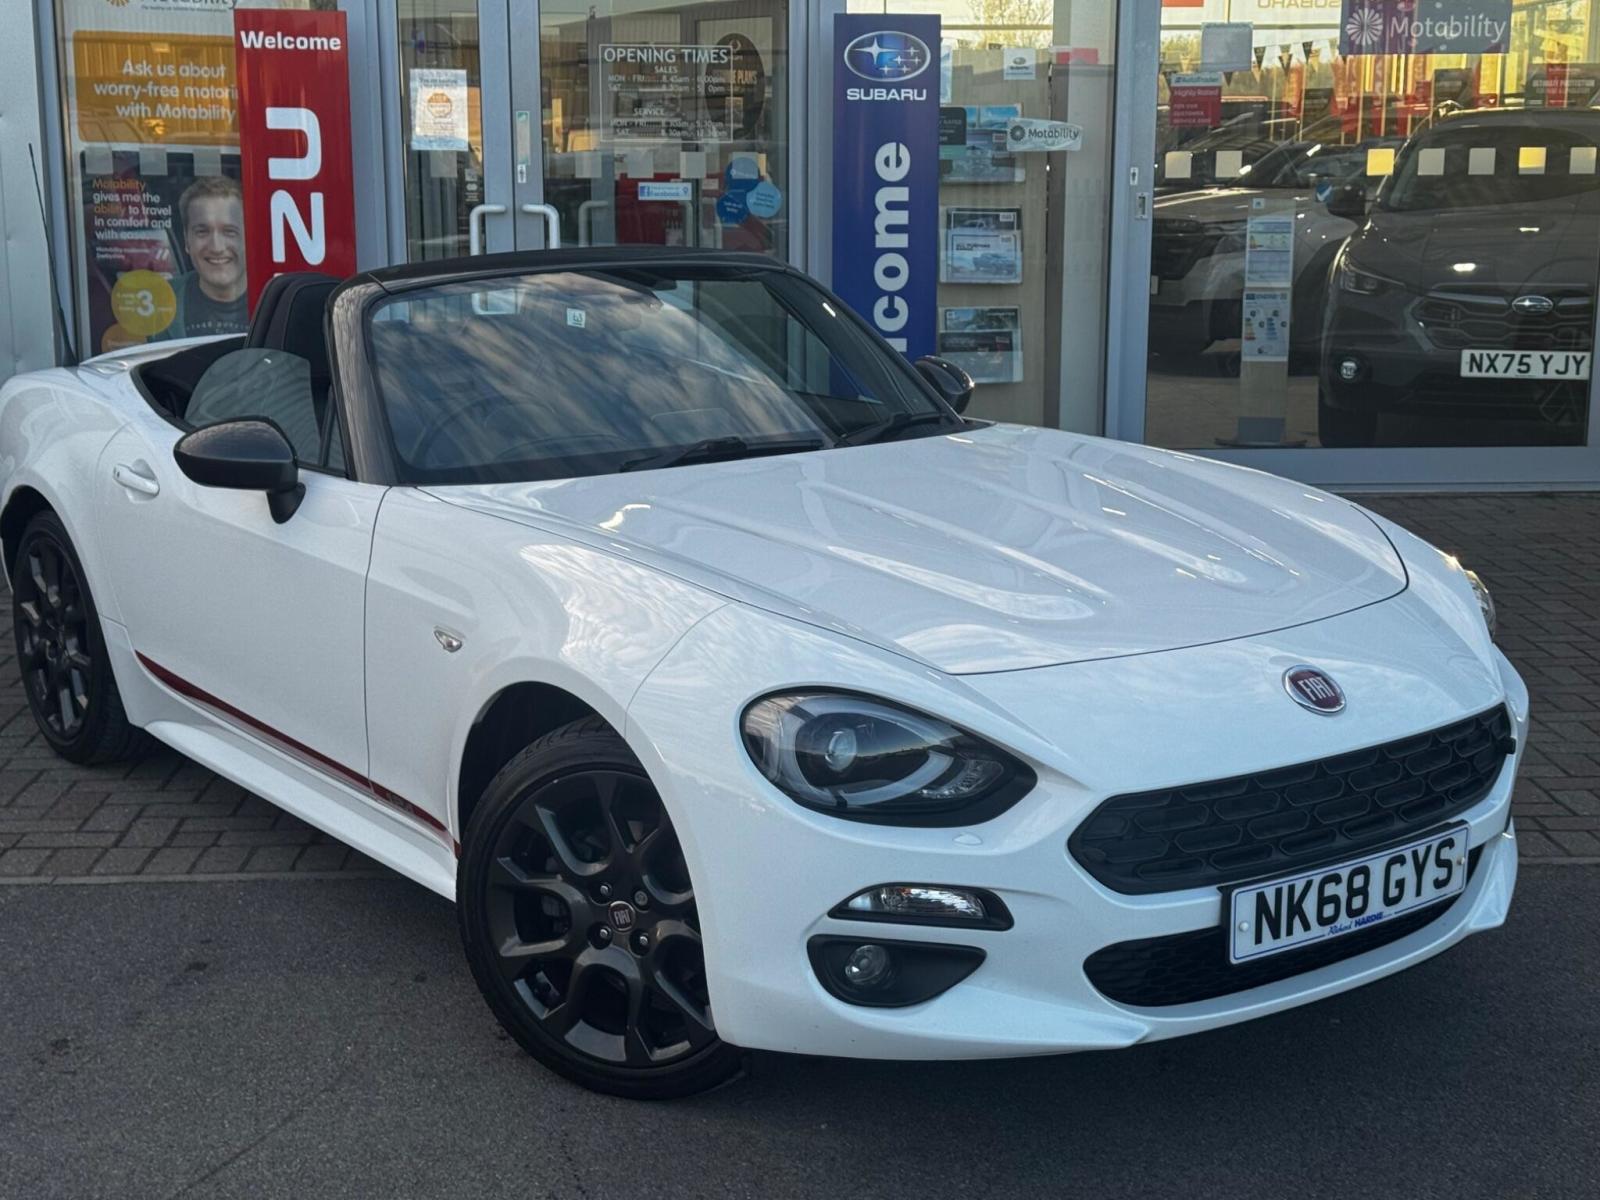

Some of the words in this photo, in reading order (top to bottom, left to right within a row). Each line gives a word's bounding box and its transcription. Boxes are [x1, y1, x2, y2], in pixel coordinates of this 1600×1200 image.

[1390, 14, 1507, 43] Motability
[239, 30, 342, 50] Welcome
[603, 48, 676, 63] OPENING
[681, 49, 728, 64] TIMES
[122, 58, 152, 76] Ask
[157, 64, 175, 77] us
[179, 61, 226, 78] about
[654, 65, 678, 74] SALES
[94, 81, 179, 100] worry-free
[846, 87, 927, 101] SUBARU
[116, 102, 150, 118] with
[156, 103, 236, 124] Motability
[633, 107, 664, 116] SERVICE
[1028, 128, 1079, 141] Motability
[93, 191, 119, 204] gives
[122, 193, 140, 202] me
[142, 192, 160, 203] the
[128, 205, 140, 215] to
[142, 205, 171, 216] travel
[95, 216, 104, 227] in
[106, 216, 148, 227] comfort
[151, 218, 171, 229] and
[95, 229, 118, 240] with
[136, 289, 154, 316] 3
[1469, 353, 1532, 374] NX75
[1540, 354, 1586, 375] YJY
[1297, 677, 1335, 701] FIAT
[1254, 865, 1371, 945] NK68
[1383, 837, 1455, 907] GYS
[614, 909, 631, 925] FIAT
